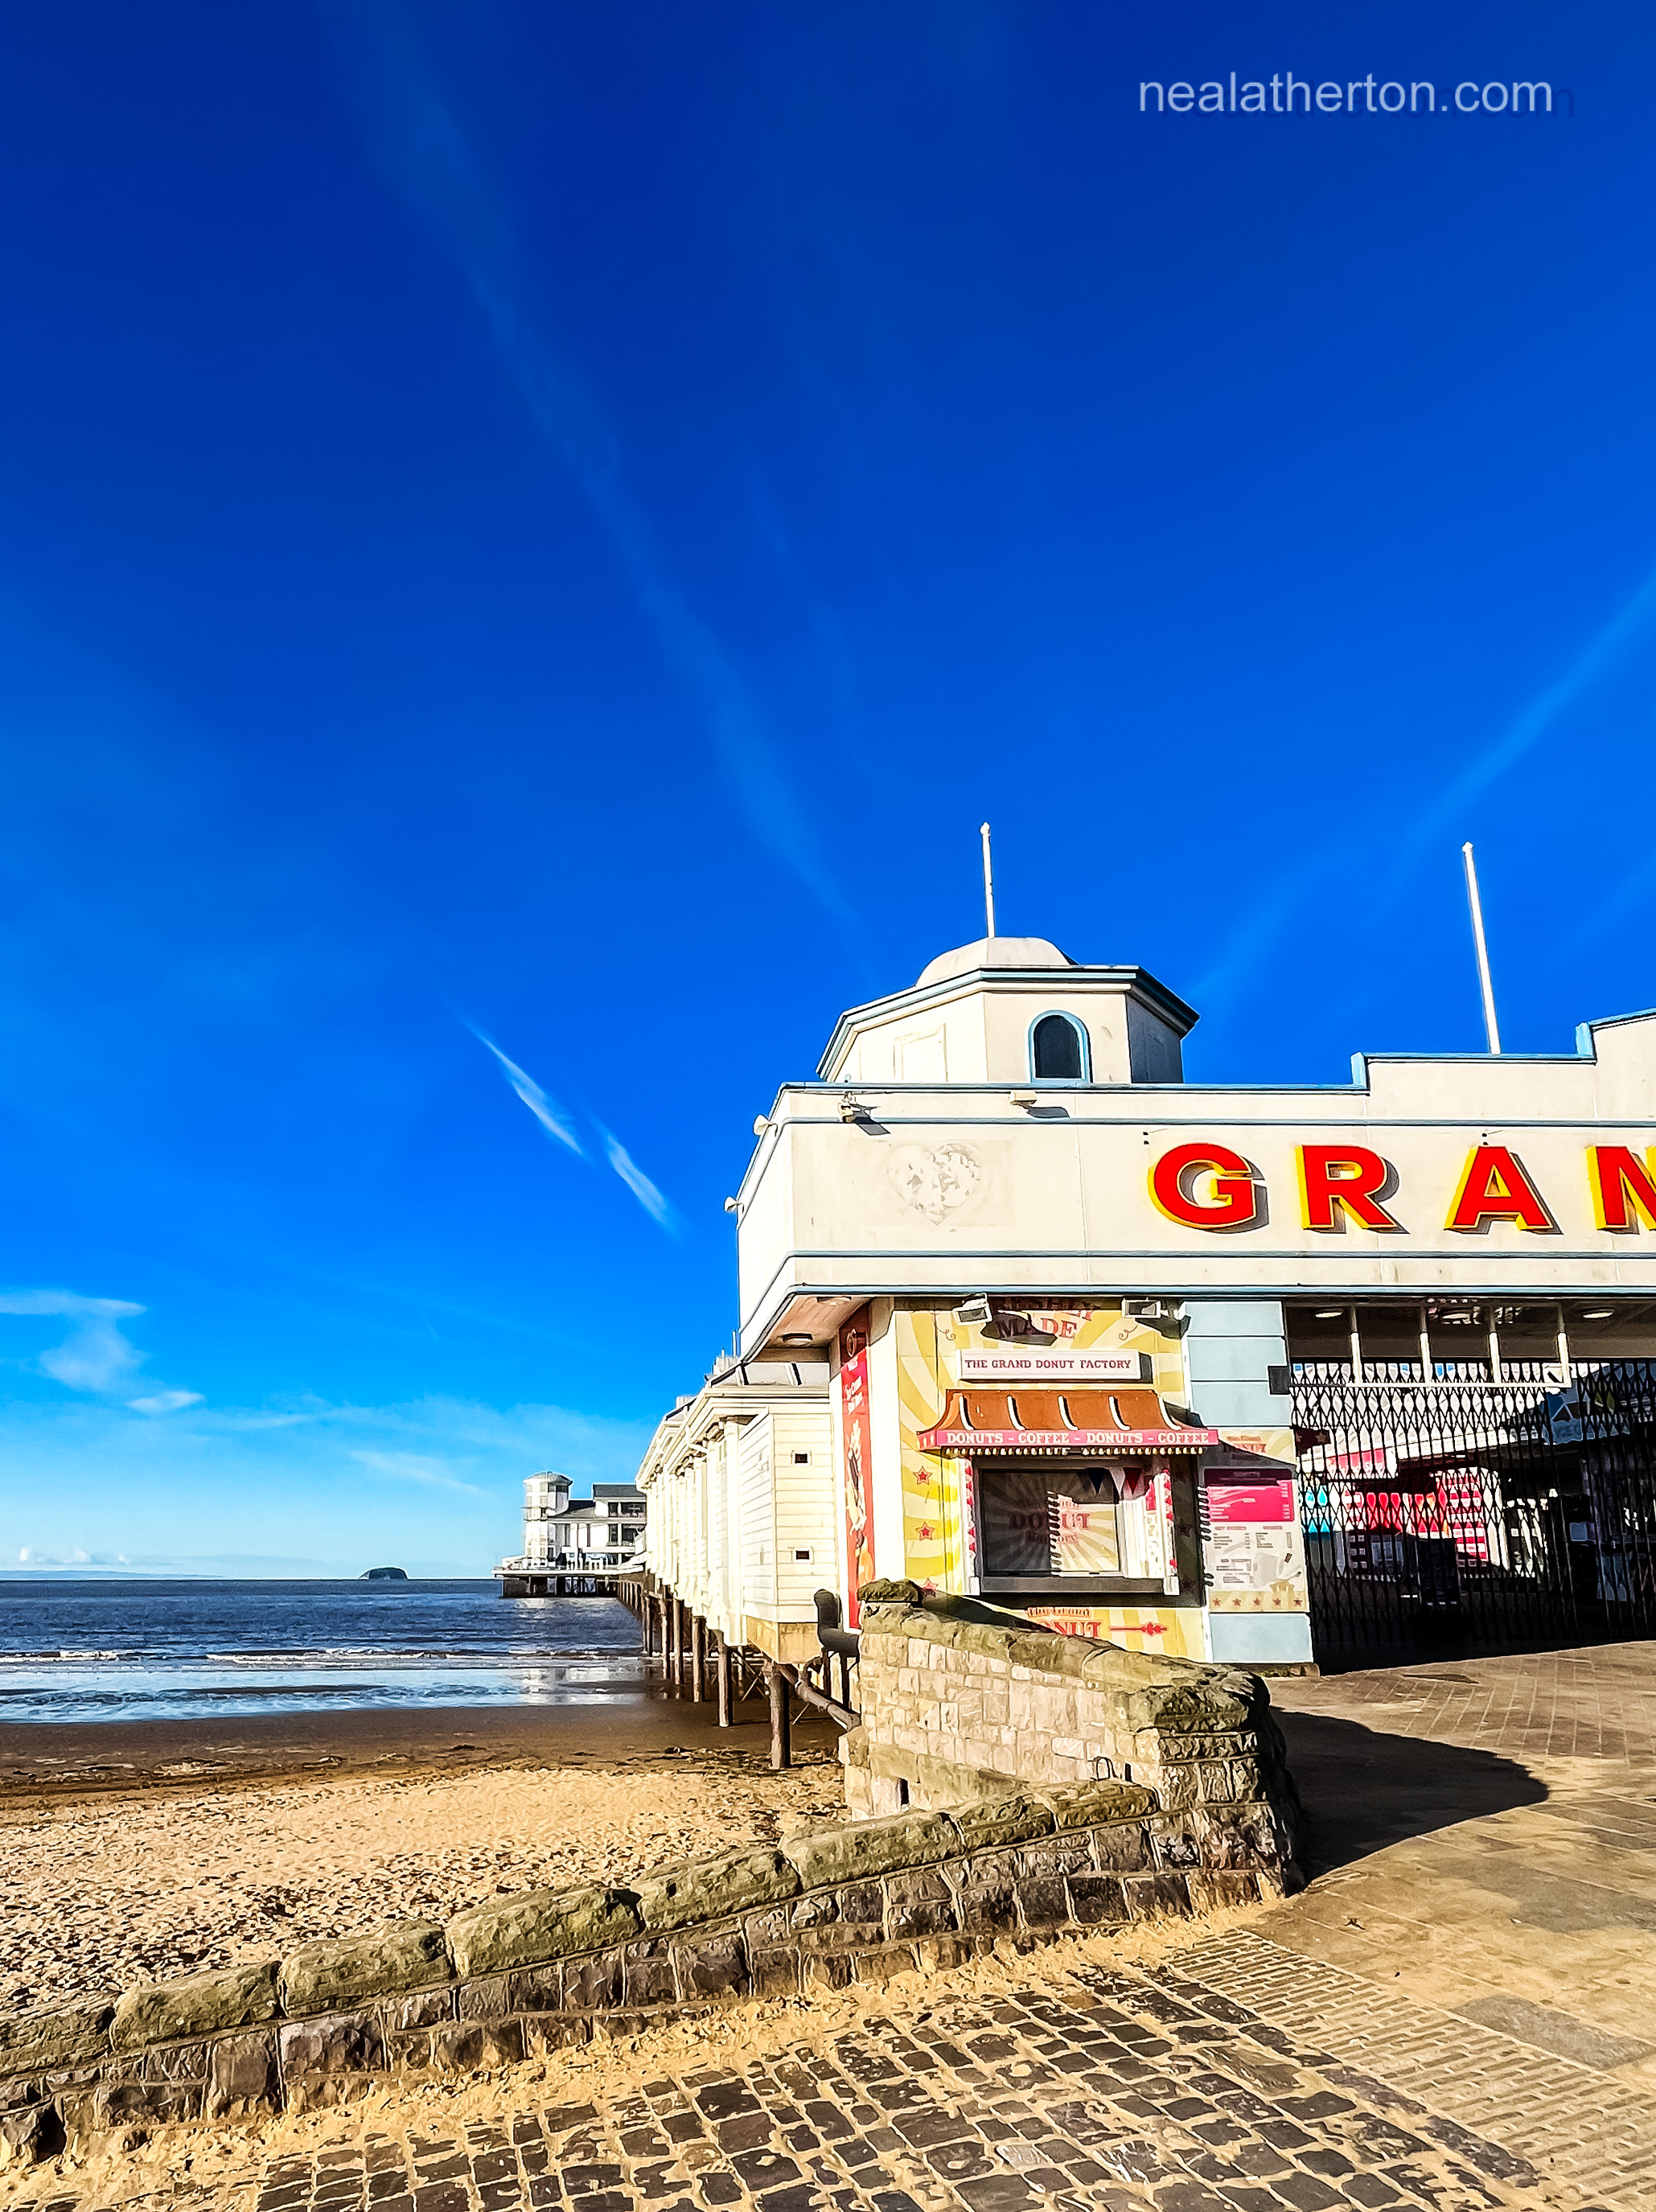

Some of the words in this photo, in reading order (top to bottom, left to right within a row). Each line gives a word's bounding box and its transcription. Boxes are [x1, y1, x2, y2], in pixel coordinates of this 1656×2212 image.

[964, 1359, 988, 1369] THE
[991, 1359, 1032, 1369] GRAND
[1035, 1359, 1075, 1369] DONUT
[1079, 1359, 1132, 1369] FACTORY
[947, 1433, 1004, 1445] DONUTS
[1017, 1433, 1070, 1445] COFFEE
[1086, 1433, 1144, 1445] DONUTS
[1157, 1433, 1210, 1445] COFFEE
